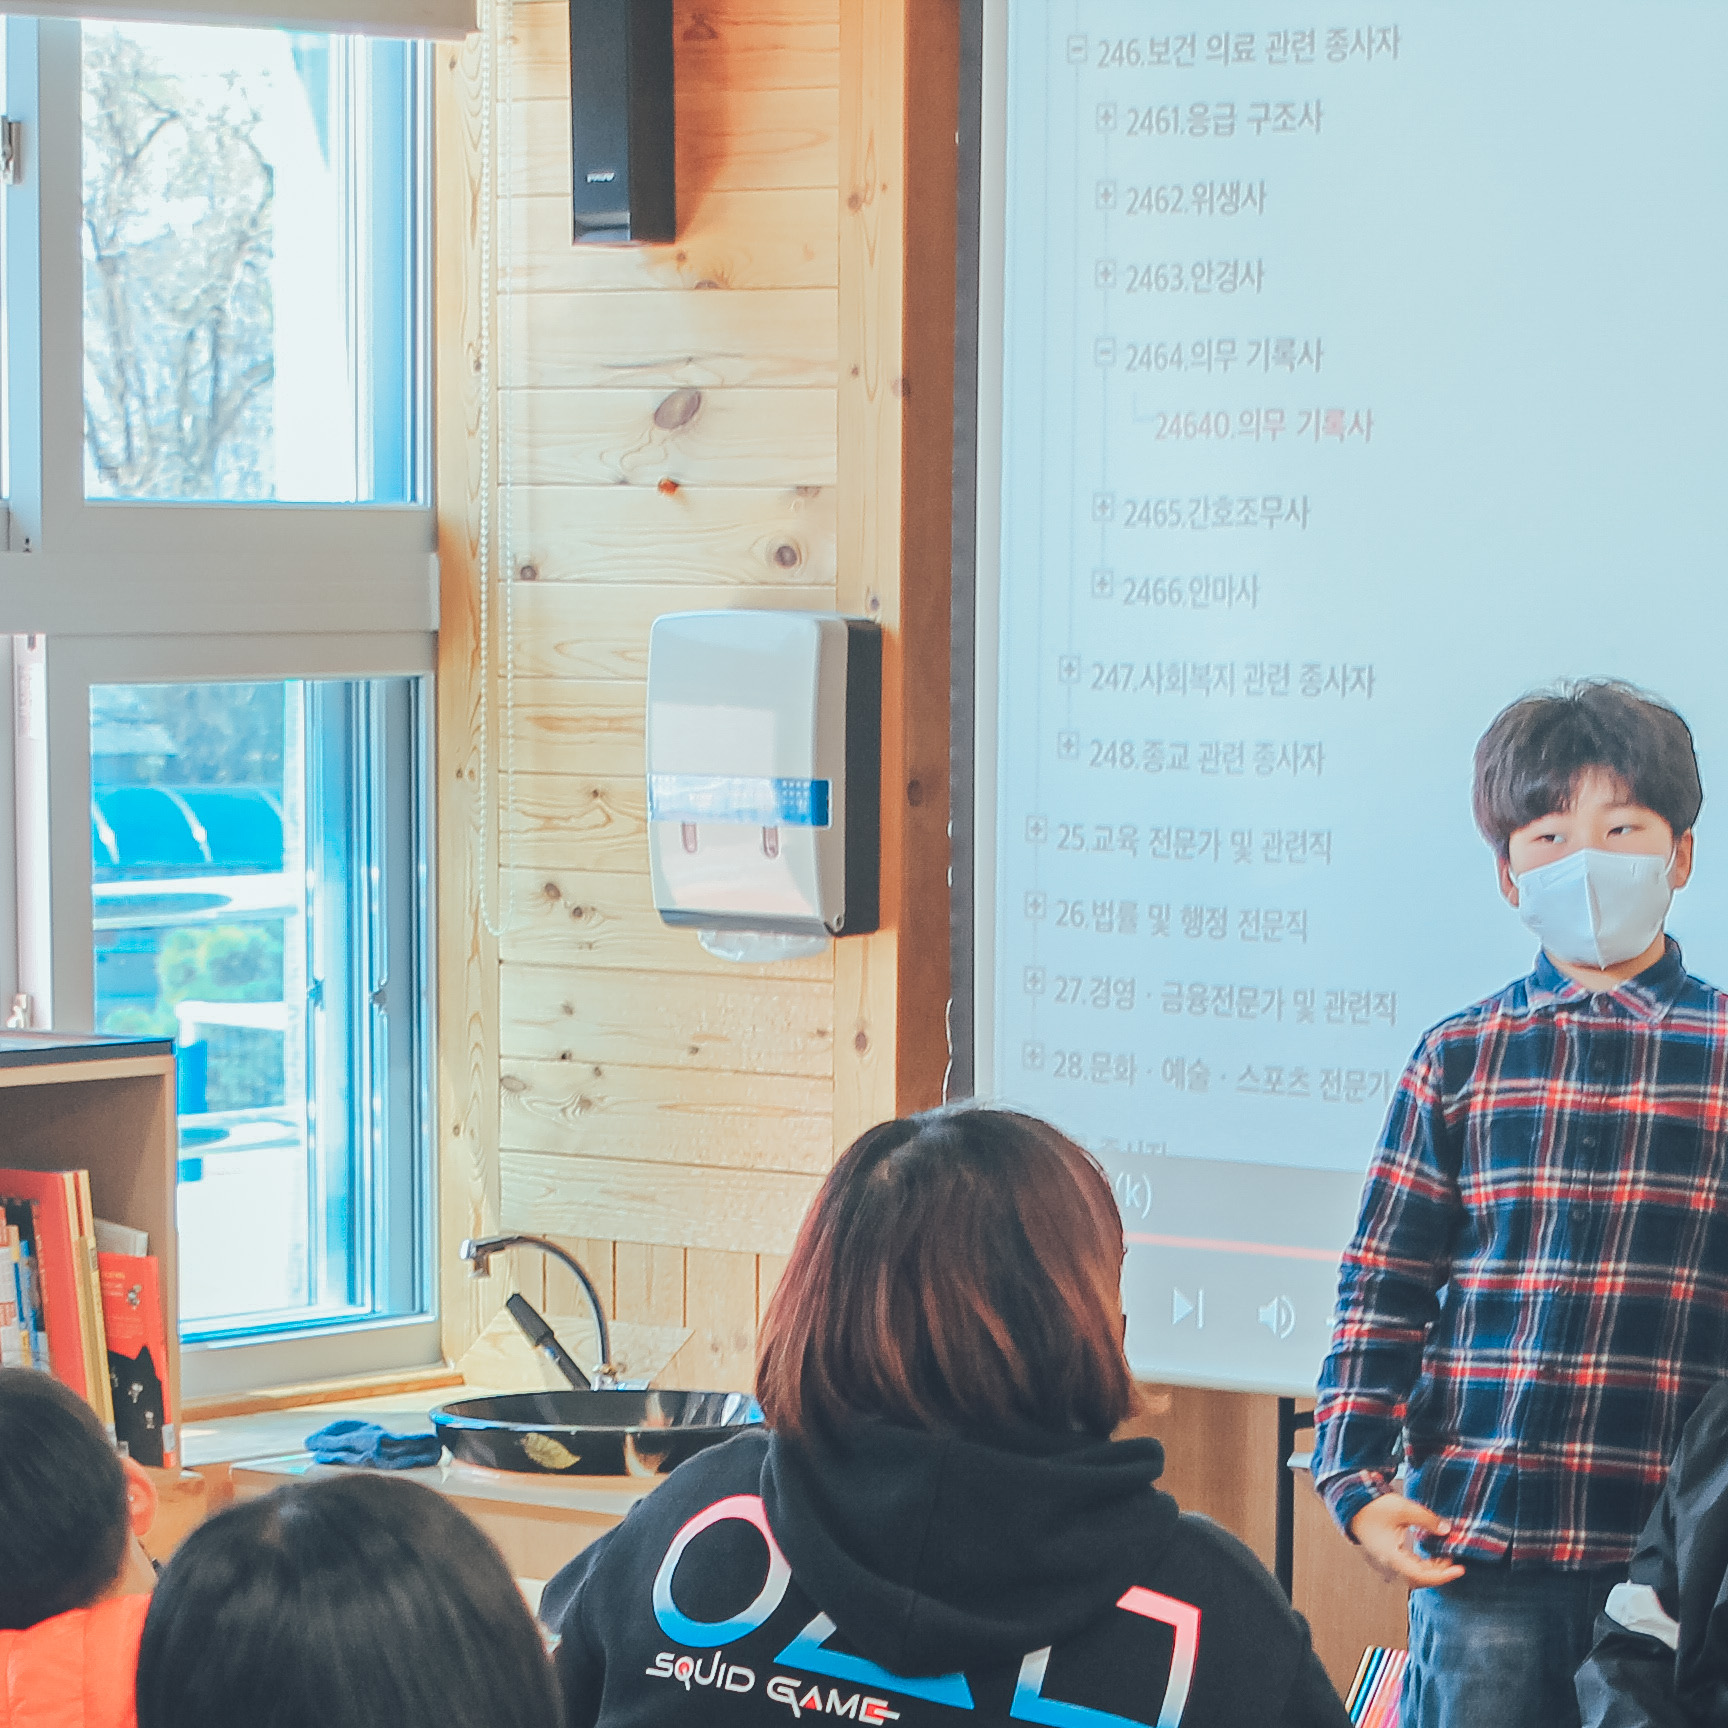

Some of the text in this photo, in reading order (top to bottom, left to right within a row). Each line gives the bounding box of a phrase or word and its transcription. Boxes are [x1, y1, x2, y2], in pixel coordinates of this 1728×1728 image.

[1098, 25, 1400, 68] 246.보건 의료 관련 종사자
[1127, 100, 1324, 137] 2461.응급 구조사
[1127, 180, 1266, 216] 2462.위생사
[1127, 260, 1264, 294] 2463.안경사
[1127, 337, 1323, 373] 2464.의무 기록사
[1156, 409, 1373, 444] 24640.의무 기록사
[1124, 495, 1310, 530] 2465.간호조무사
[1124, 575, 1259, 608] 2466.안마사
[1092, 661, 1375, 698] 247.사회복지 관련 종사자
[1089, 741, 1325, 776] 248.종교 관련 종사자
[1058, 824, 1332, 865] 25.교육 전문가 및 관련직
[1056, 900, 1308, 943] 26.법률 및 행정 전문직
[1054, 975, 1397, 1026] 27.경영 금융전문가 및 관련직
[1054, 1050, 1136, 1086] 28.문화
[1162, 1058, 1209, 1094] 예술
[1238, 1066, 1309, 1097] 스포츠
[646, 1651, 899, 1726] SQUID GAME
